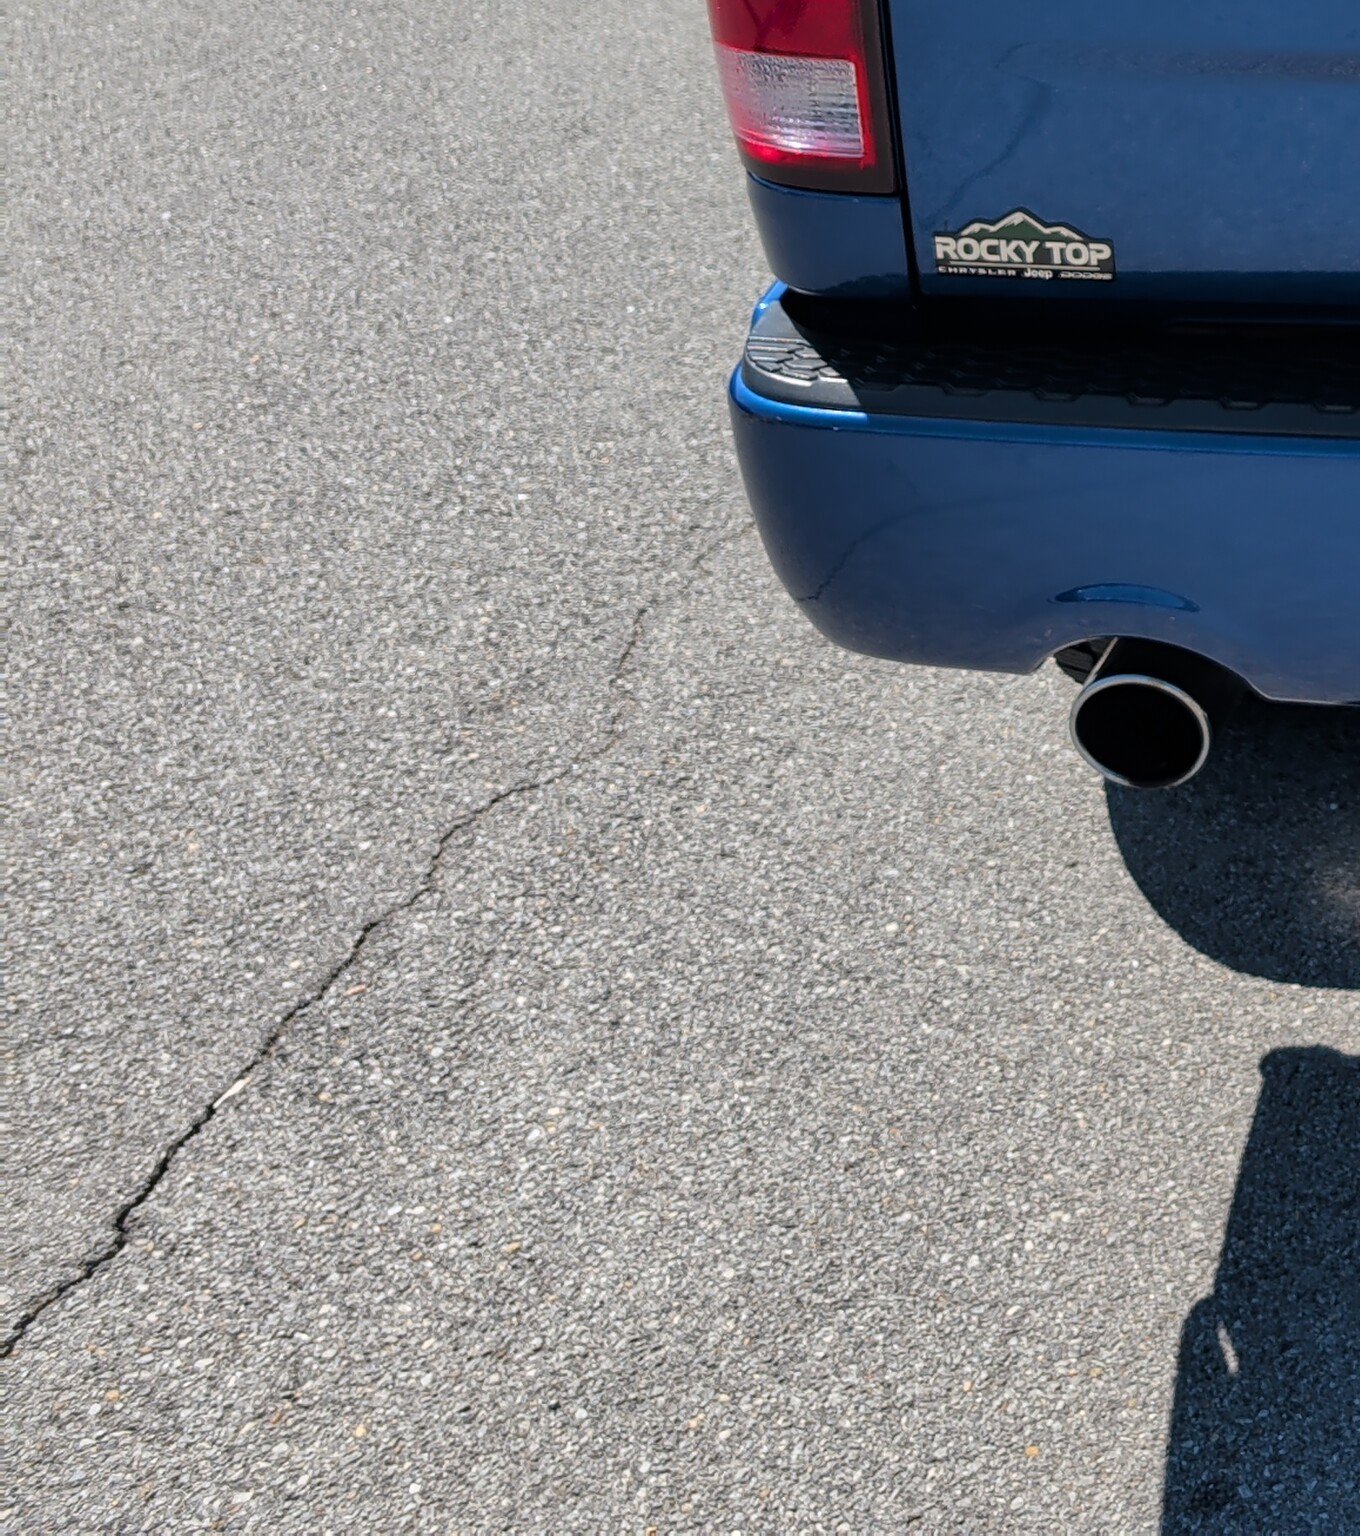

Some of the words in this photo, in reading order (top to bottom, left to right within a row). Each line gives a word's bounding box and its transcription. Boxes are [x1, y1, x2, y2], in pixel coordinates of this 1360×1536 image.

[935, 235, 1040, 264] ROCKY
[1045, 241, 1112, 266] TOP
[938, 266, 1016, 276] CHRYSLER
[1023, 267, 1053, 280] Jeep
